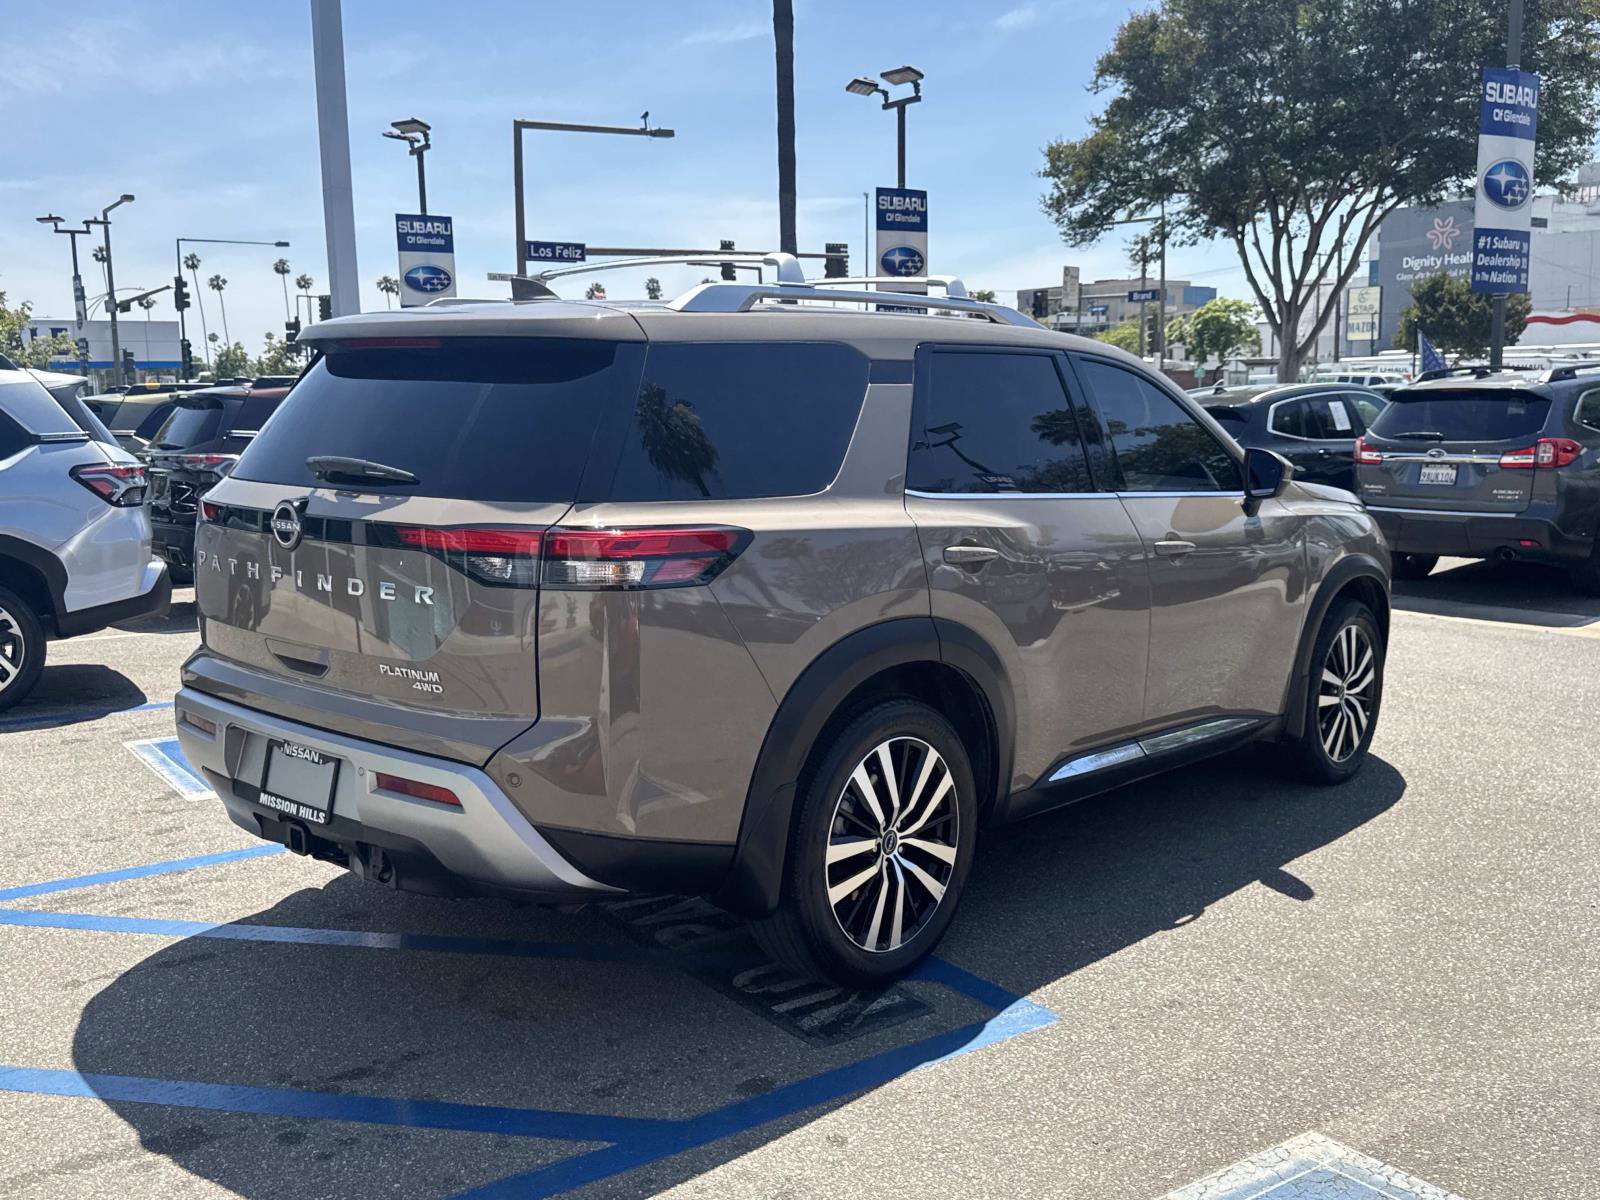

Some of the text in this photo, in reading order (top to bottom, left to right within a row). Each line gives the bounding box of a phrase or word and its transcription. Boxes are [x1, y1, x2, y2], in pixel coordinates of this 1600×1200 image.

[1485, 81, 1538, 109] SUBARU
[1493, 108, 1531, 126] Of Glendale
[879, 195, 926, 211] SUBARU
[398, 220, 451, 235] SUBARU
[407, 236, 415, 244] Of
[1478, 236, 1520, 250] #1 Subaru
[530, 245, 582, 259] Los Feliz
[1402, 250, 1473, 271] Dignity Healt
[1477, 253, 1521, 270] Dealership
[1490, 270, 1517, 284] Nation
[199, 550, 434, 605] PATHFINDER
[379, 664, 440, 682] PLATINUM
[412, 681, 443, 693] 4WD
[283, 742, 319, 763] NISSAN
[259, 791, 326, 824] MISSION HILLS
